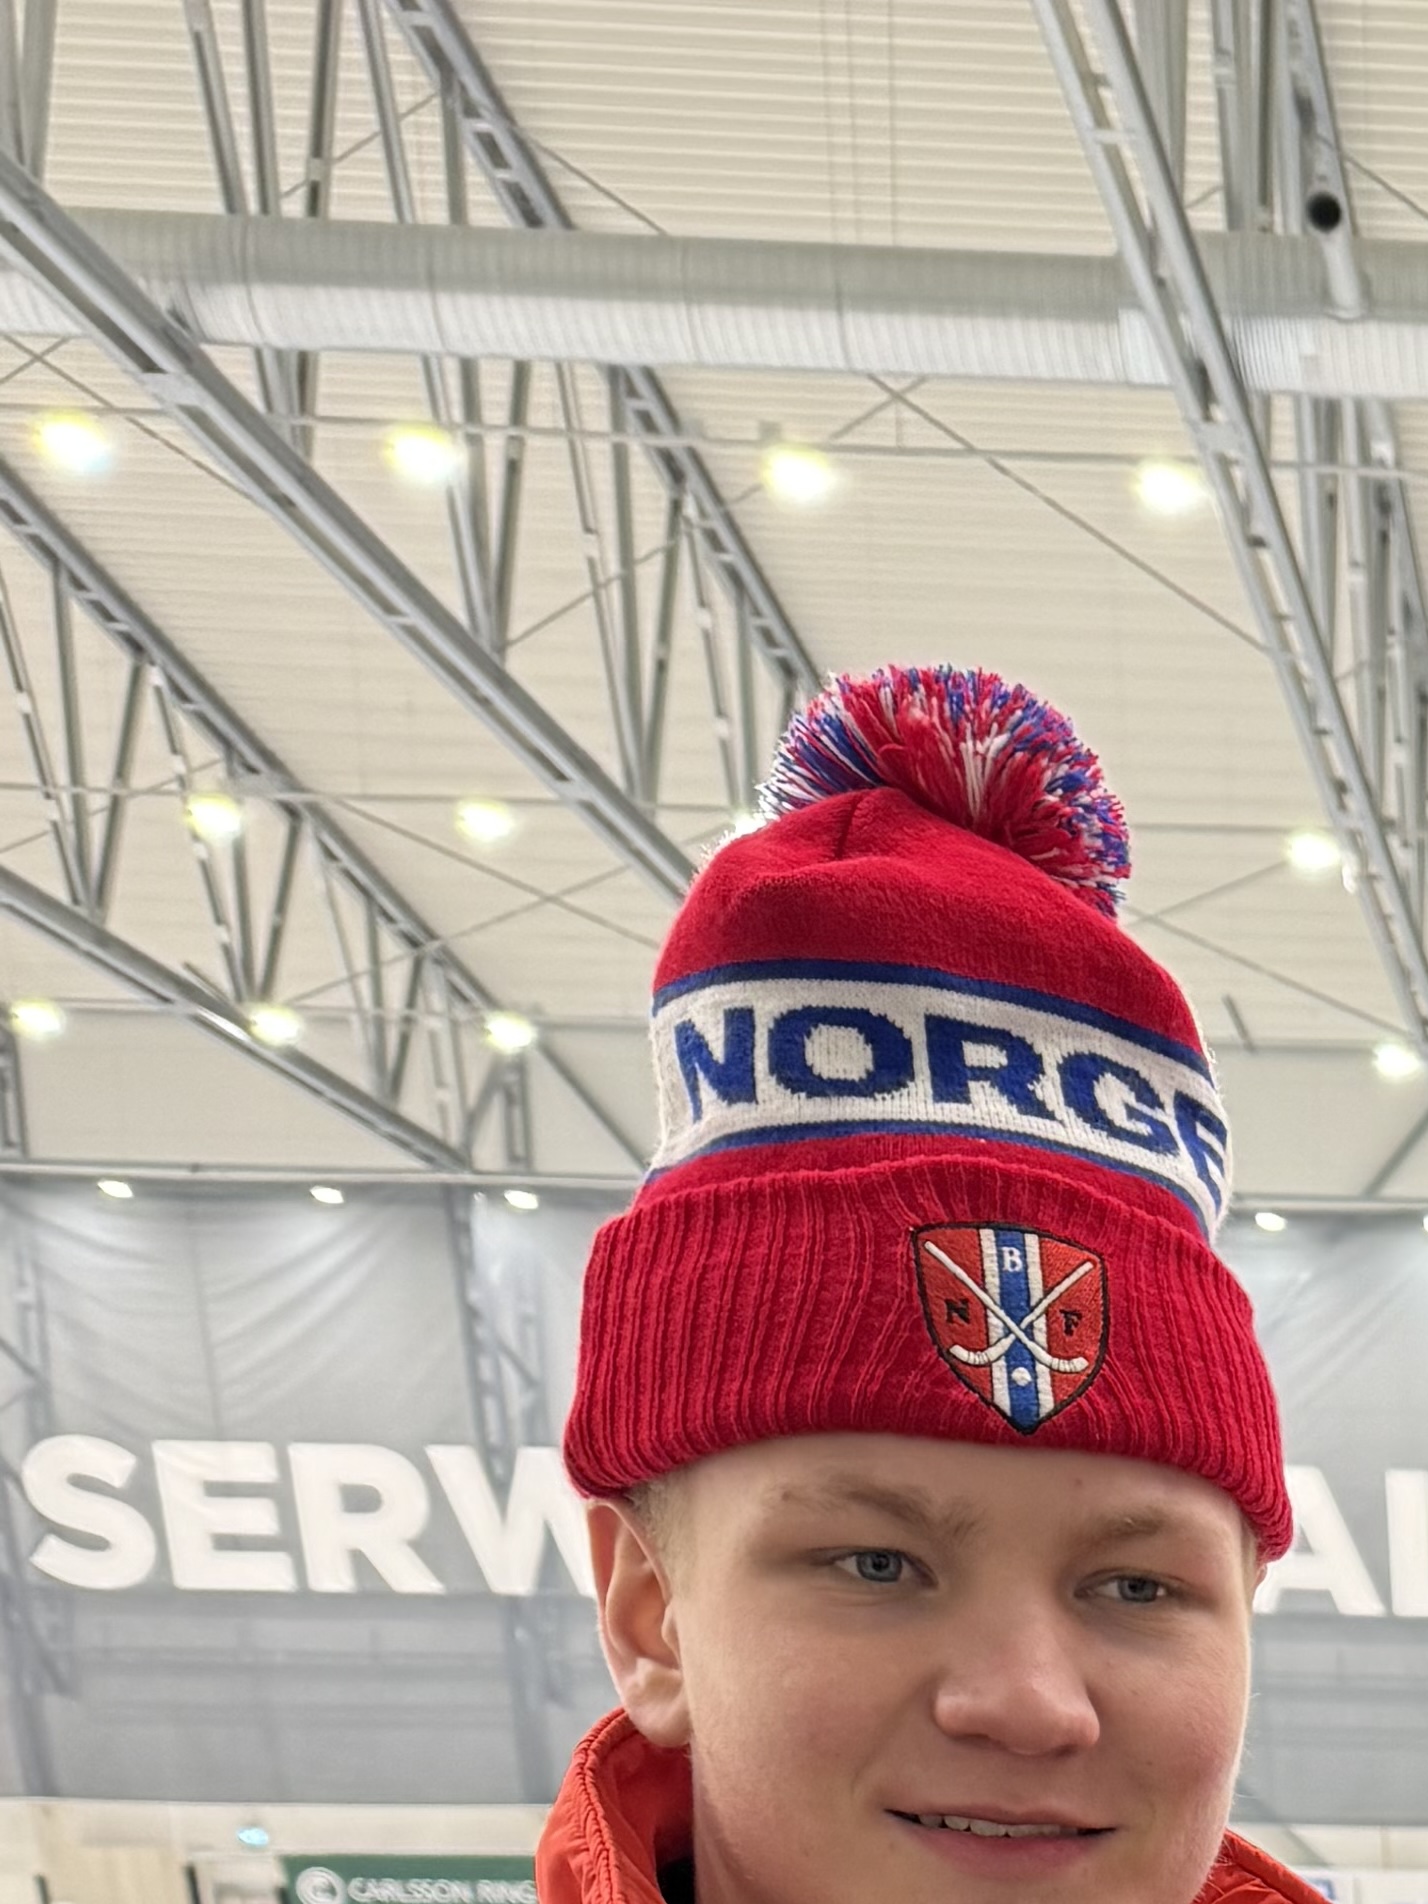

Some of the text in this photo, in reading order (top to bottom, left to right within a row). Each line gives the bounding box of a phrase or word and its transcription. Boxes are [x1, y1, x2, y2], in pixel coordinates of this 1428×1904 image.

[1000, 1247, 1024, 1272] B
[944, 1298, 1083, 1336] N F
